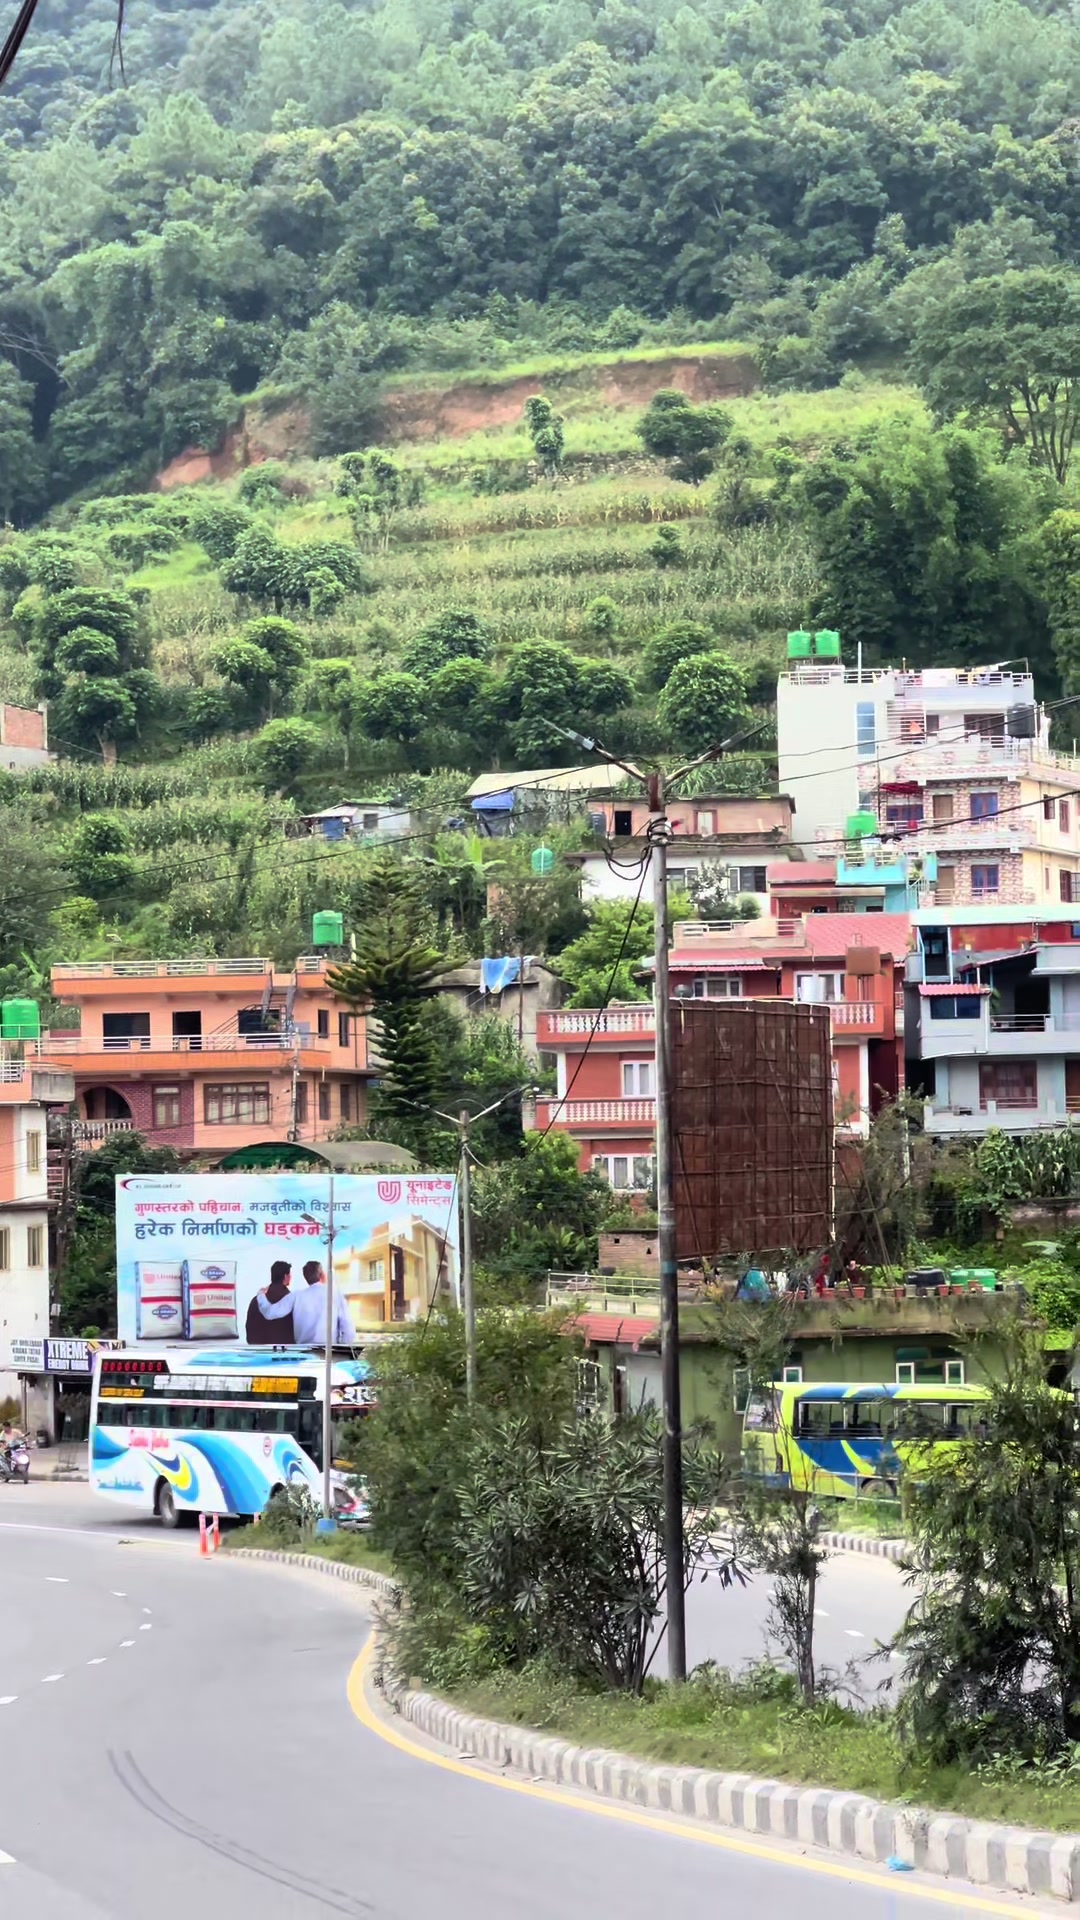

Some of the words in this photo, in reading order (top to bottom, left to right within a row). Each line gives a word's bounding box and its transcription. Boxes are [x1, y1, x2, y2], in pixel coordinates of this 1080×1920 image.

[406, 1178, 452, 1193] यूनाइटेड
[134, 1199, 194, 1216] गुणस्तरको
[249, 1199, 305, 1215] मजबुतीको
[134, 1218, 176, 1239] हरेक
[182, 1218, 258, 1236] निर्माणको
[47, 1340, 89, 1359] XTREME
[47, 1358, 69, 1369] ENERGY
